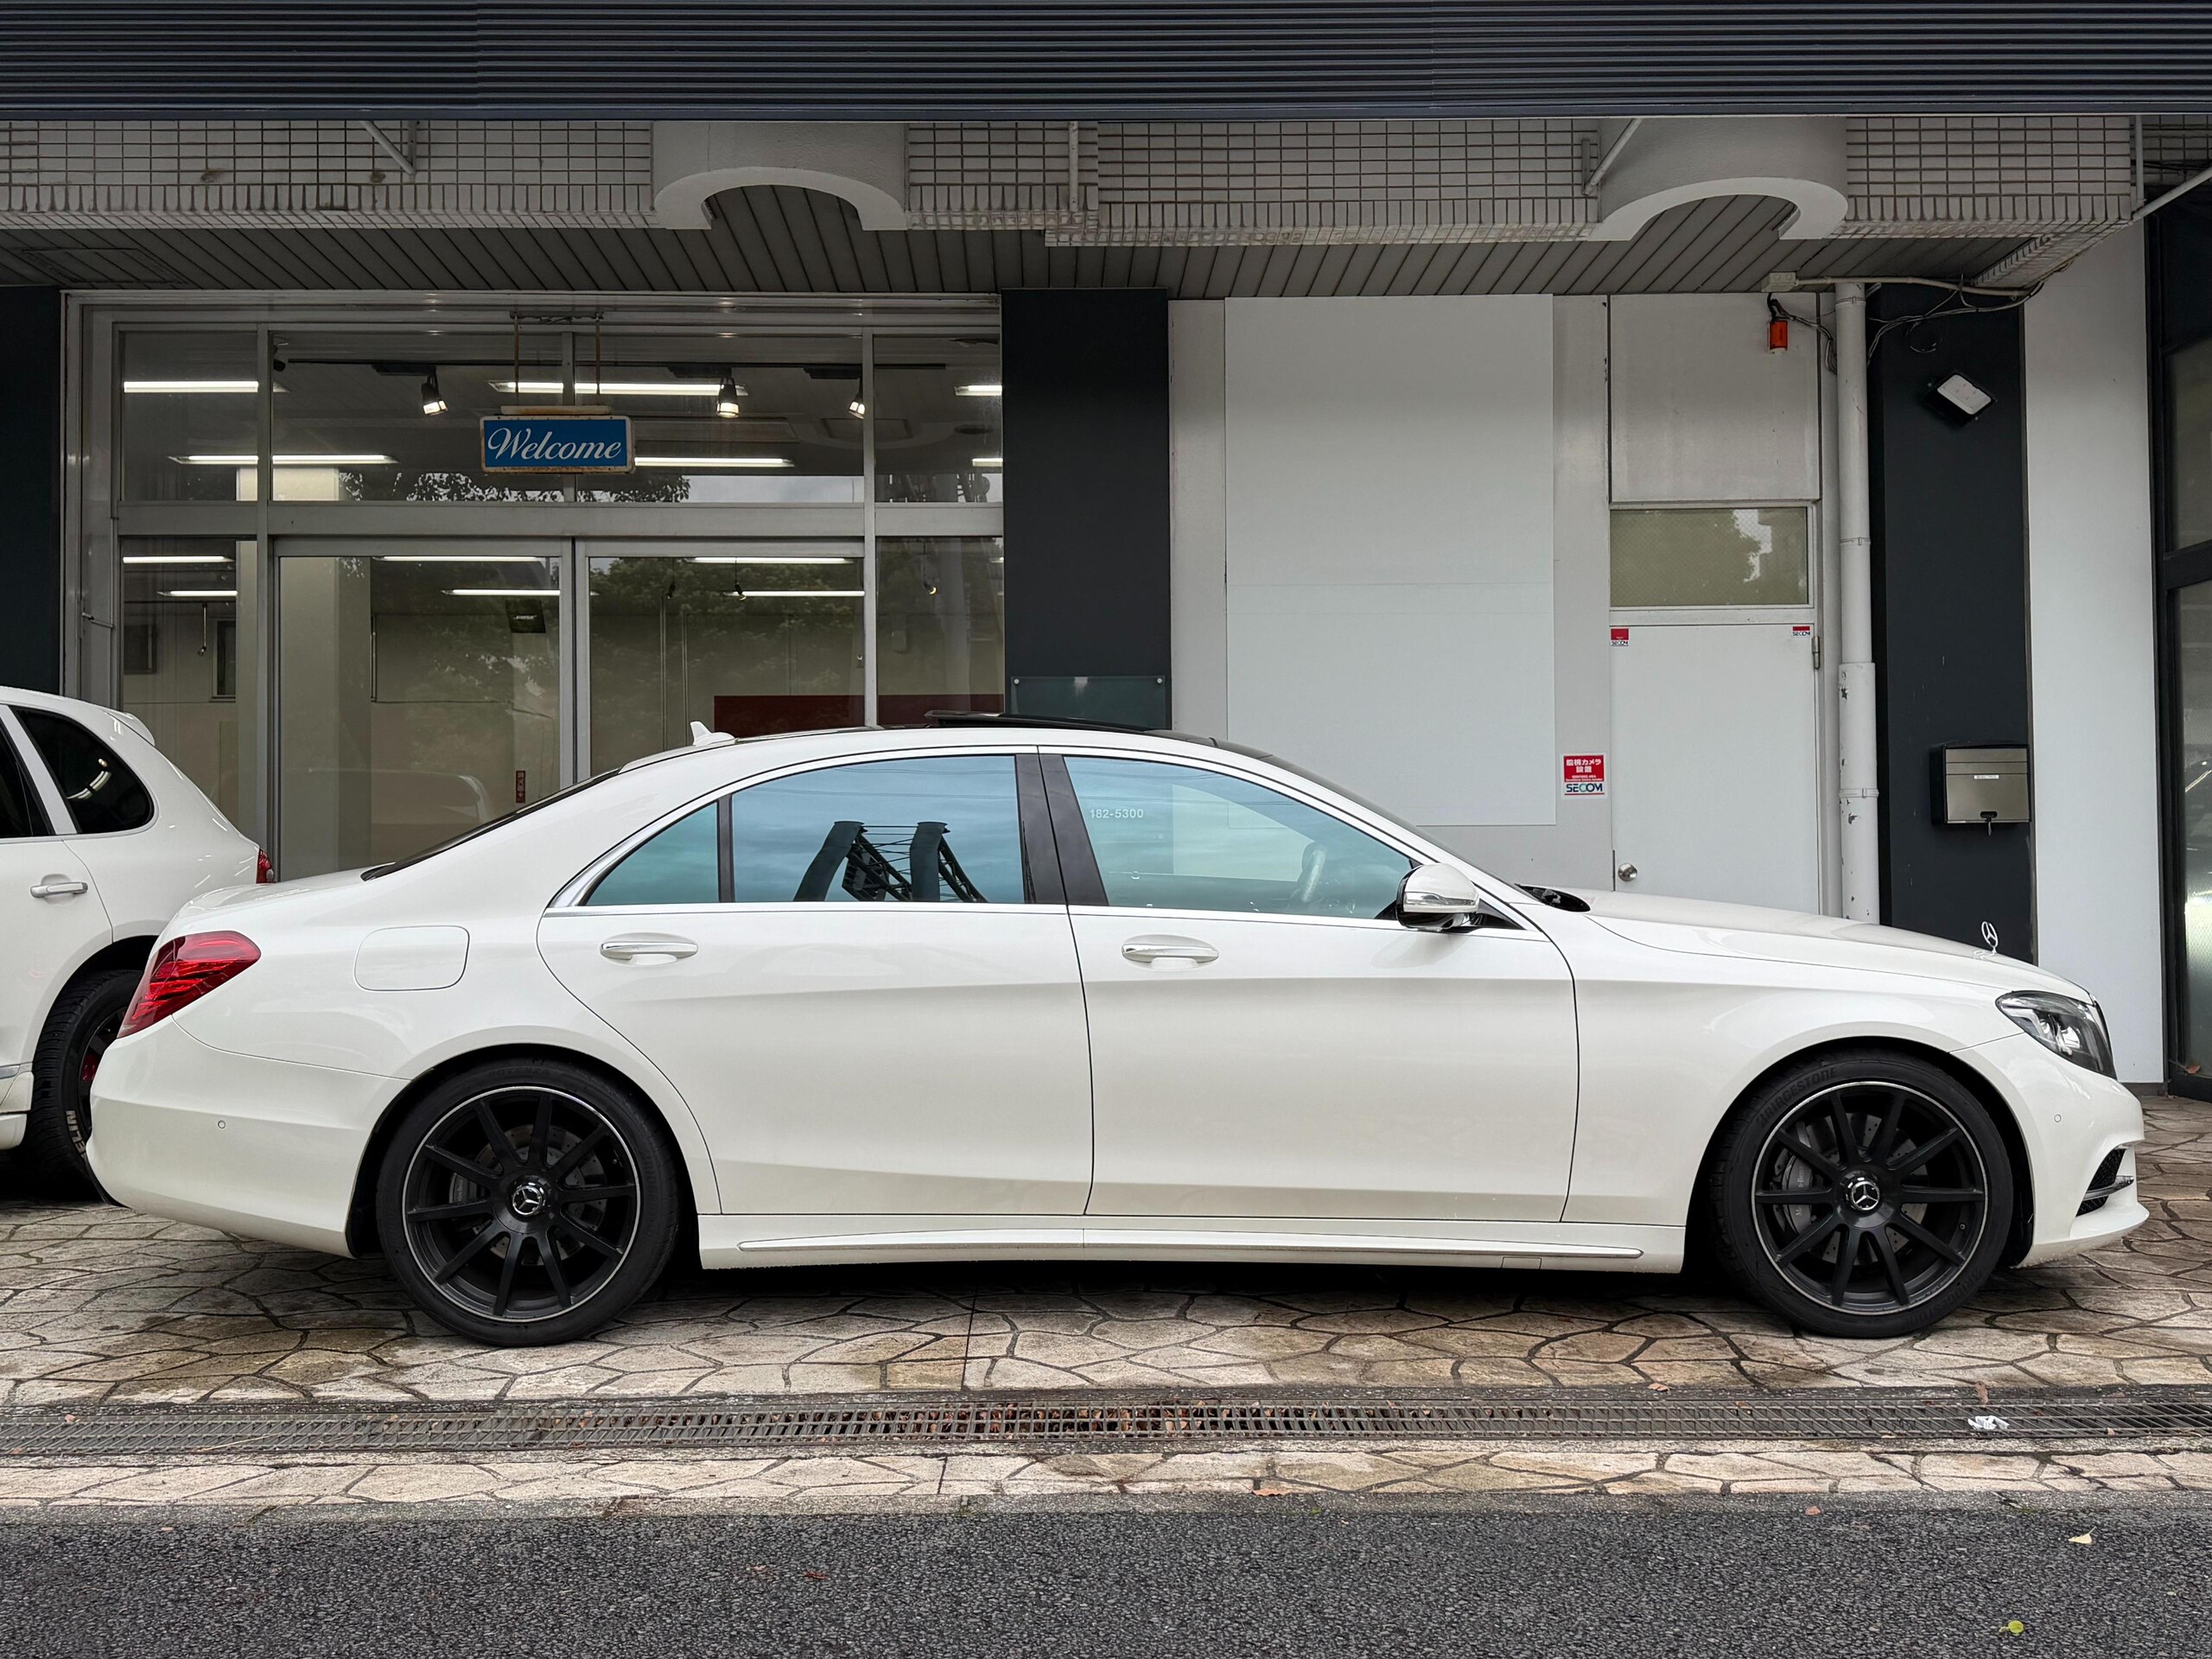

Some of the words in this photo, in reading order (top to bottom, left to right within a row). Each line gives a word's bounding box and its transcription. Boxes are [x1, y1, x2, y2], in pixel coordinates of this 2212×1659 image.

[487, 427, 622, 460] Welcome
[1566, 783, 1603, 792] SECOM
[1756, 1067, 1838, 1128] BRIDGESTONE
